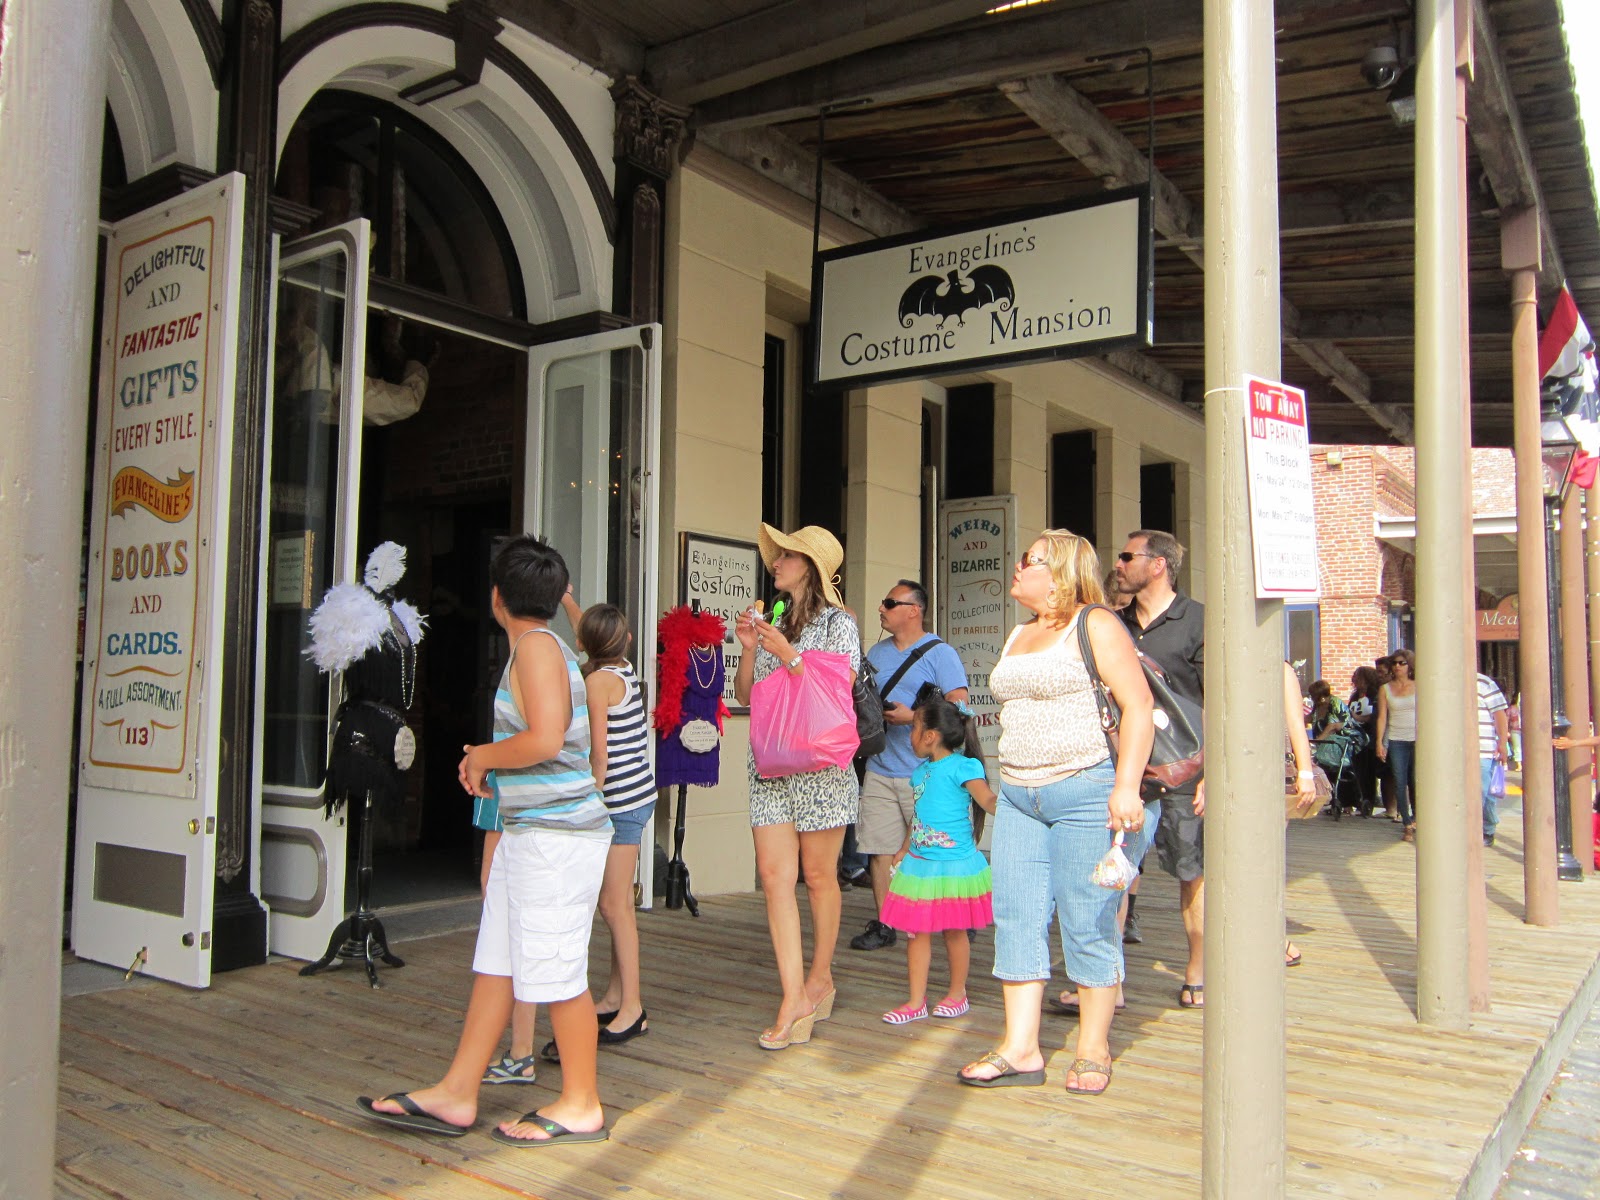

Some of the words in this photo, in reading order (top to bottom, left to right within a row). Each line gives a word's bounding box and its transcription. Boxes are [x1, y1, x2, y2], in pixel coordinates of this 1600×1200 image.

[908, 226, 1036, 275] Evangeline's
[124, 244, 206, 296] DELIGHTFUL
[146, 282, 181, 309] AND
[120, 312, 203, 358] FANTASTIC
[840, 328, 955, 366] Costume
[989, 299, 1112, 345] Mansion
[119, 359, 199, 409] GIFTS
[1254, 391, 1272, 412] TOW
[1277, 397, 1300, 419] AWAY
[115, 421, 151, 453] EVERY
[155, 412, 197, 445] STYLE.
[1253, 416, 1265, 438] NO
[1270, 423, 1303, 449] PARKING
[1265, 451, 1279, 465] This
[1281, 454, 1299, 468] Block
[114, 475, 191, 516] EVANGELINE'S
[949, 519, 1001, 540] WEIRD
[963, 541, 988, 551] AND
[111, 539, 188, 582] BOOKS
[692, 550, 750, 573] Evangeline's
[951, 558, 1000, 574] BIZARRE
[689, 571, 752, 600] Costume
[958, 593, 966, 602] A
[129, 594, 162, 614] AND
[691, 598, 741, 622] ansio
[951, 603, 1001, 620] COLLECTION
[952, 627, 961, 636] OF
[963, 625, 1001, 635] RARITIES.
[1481, 611, 1518, 626] Mea
[107, 631, 183, 656] CARDS.
[972, 658, 981, 668] &
[98, 688, 105, 709] A
[105, 685, 124, 710] FULL
[126, 680, 183, 712] ASSORTMENT.
[973, 711, 1001, 729] OKS
[125, 726, 150, 746] 113
